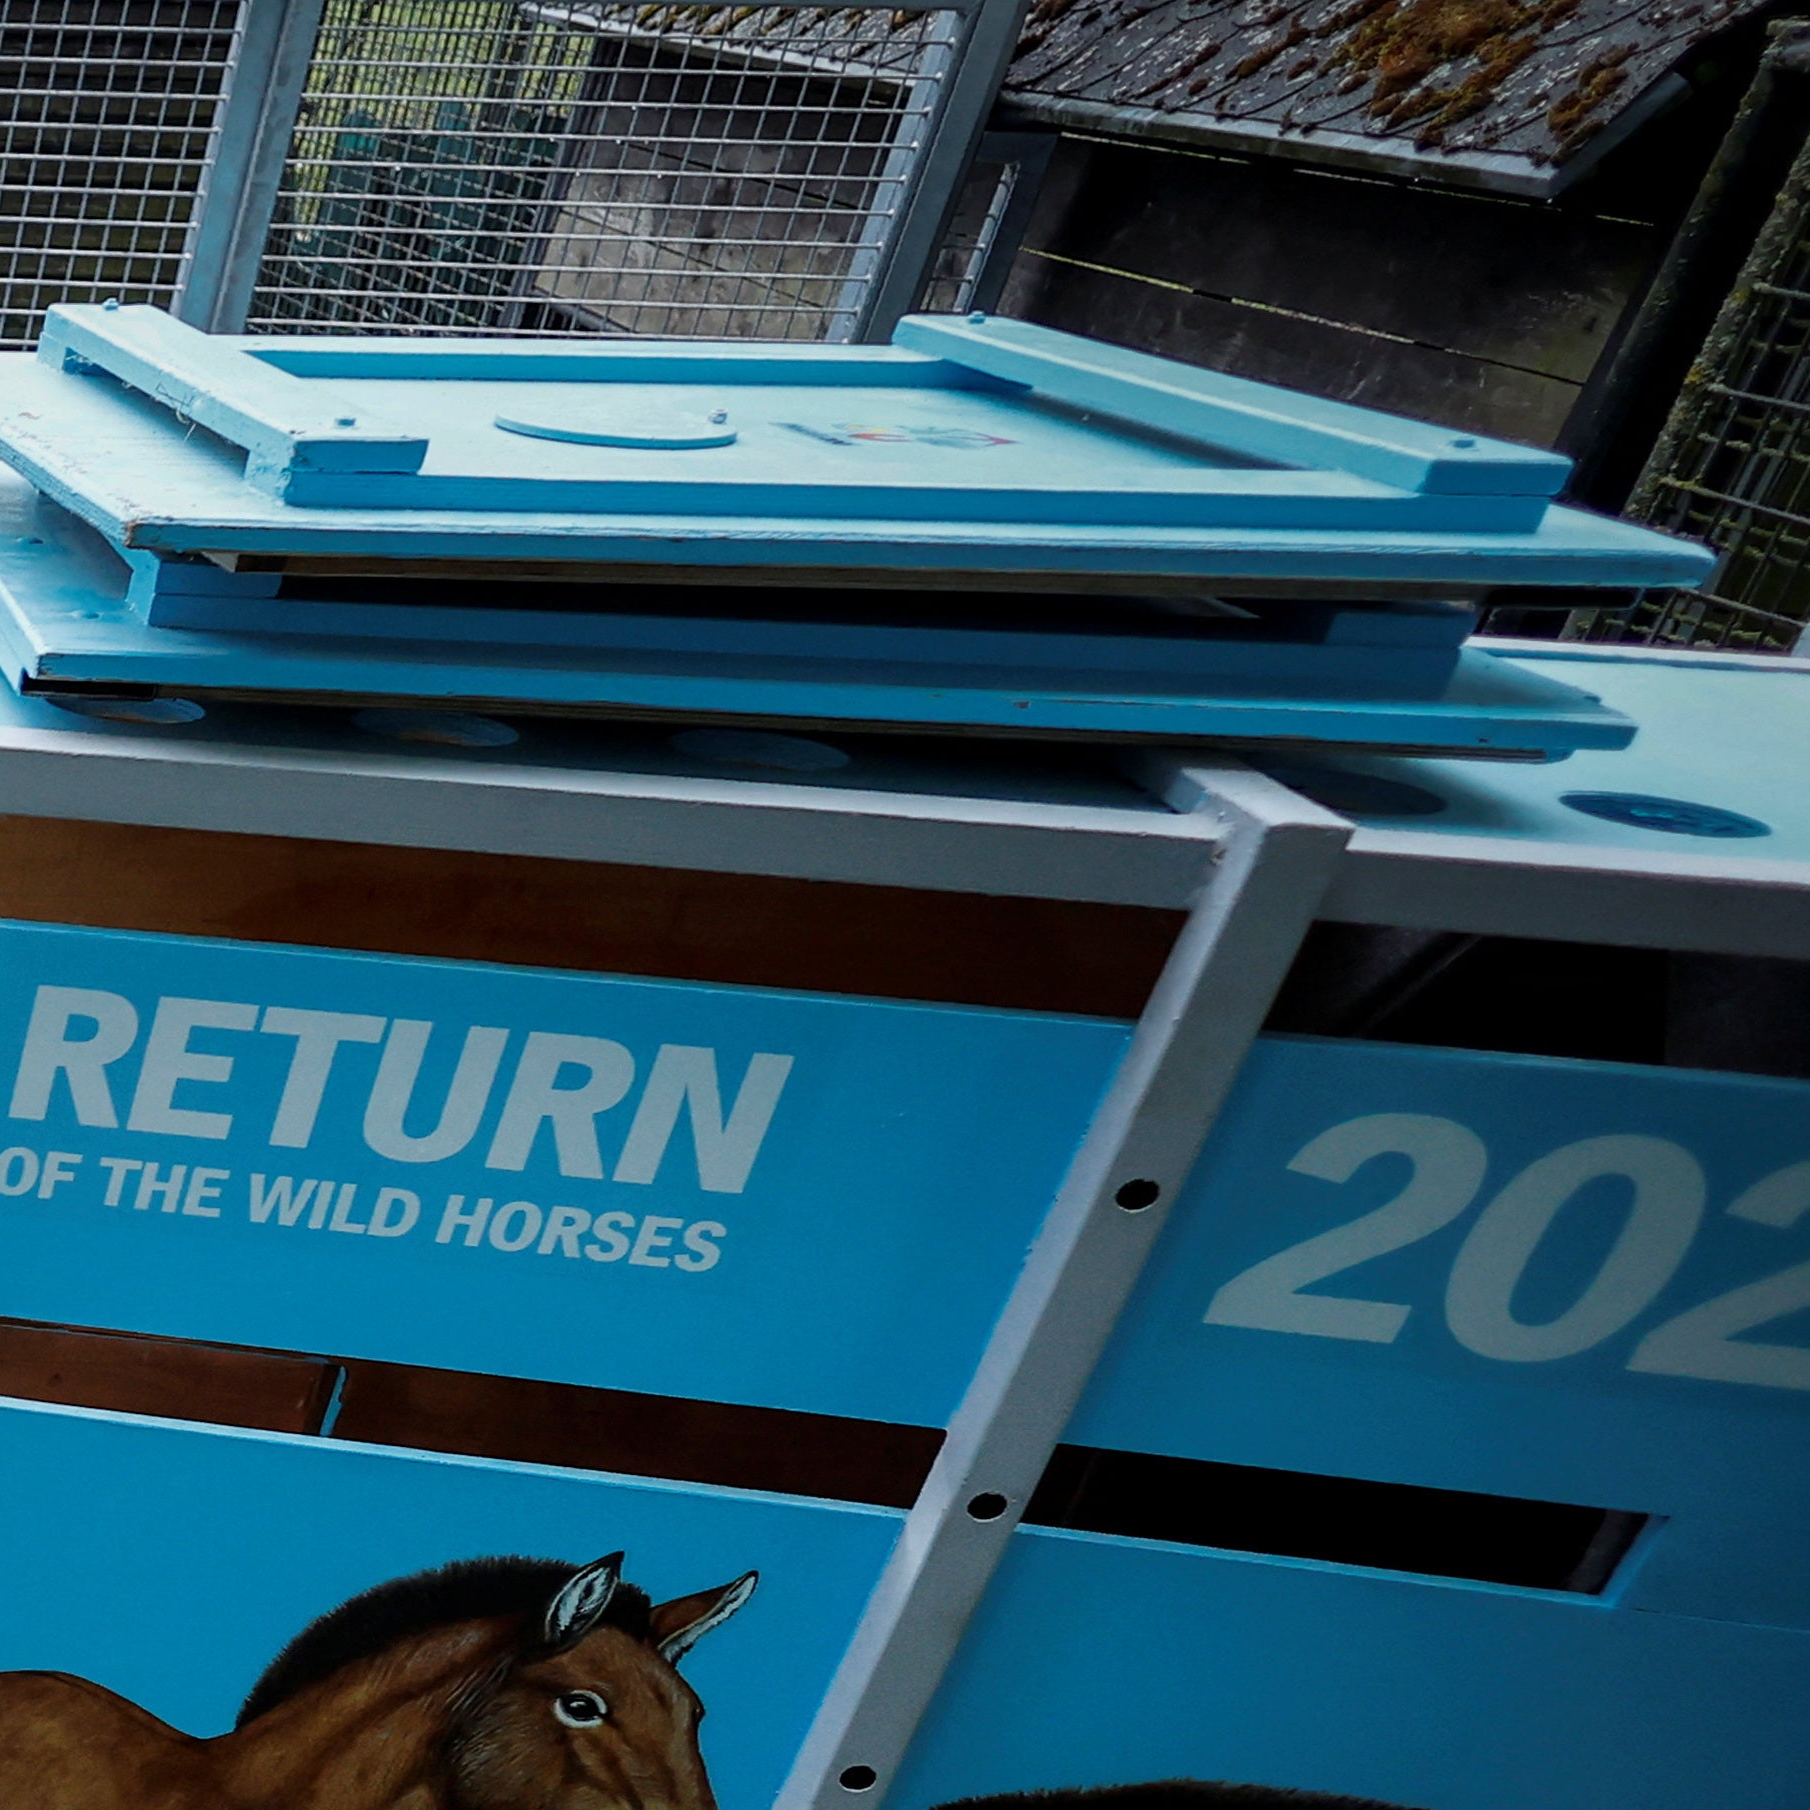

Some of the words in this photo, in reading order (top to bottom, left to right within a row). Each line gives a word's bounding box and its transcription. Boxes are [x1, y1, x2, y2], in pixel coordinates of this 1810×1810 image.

[6, 984, 794, 1194] RETURN
[100, 1156, 232, 1219] THE
[247, 1173, 421, 1240] WILD
[435, 1195, 728, 1274] HORSES
